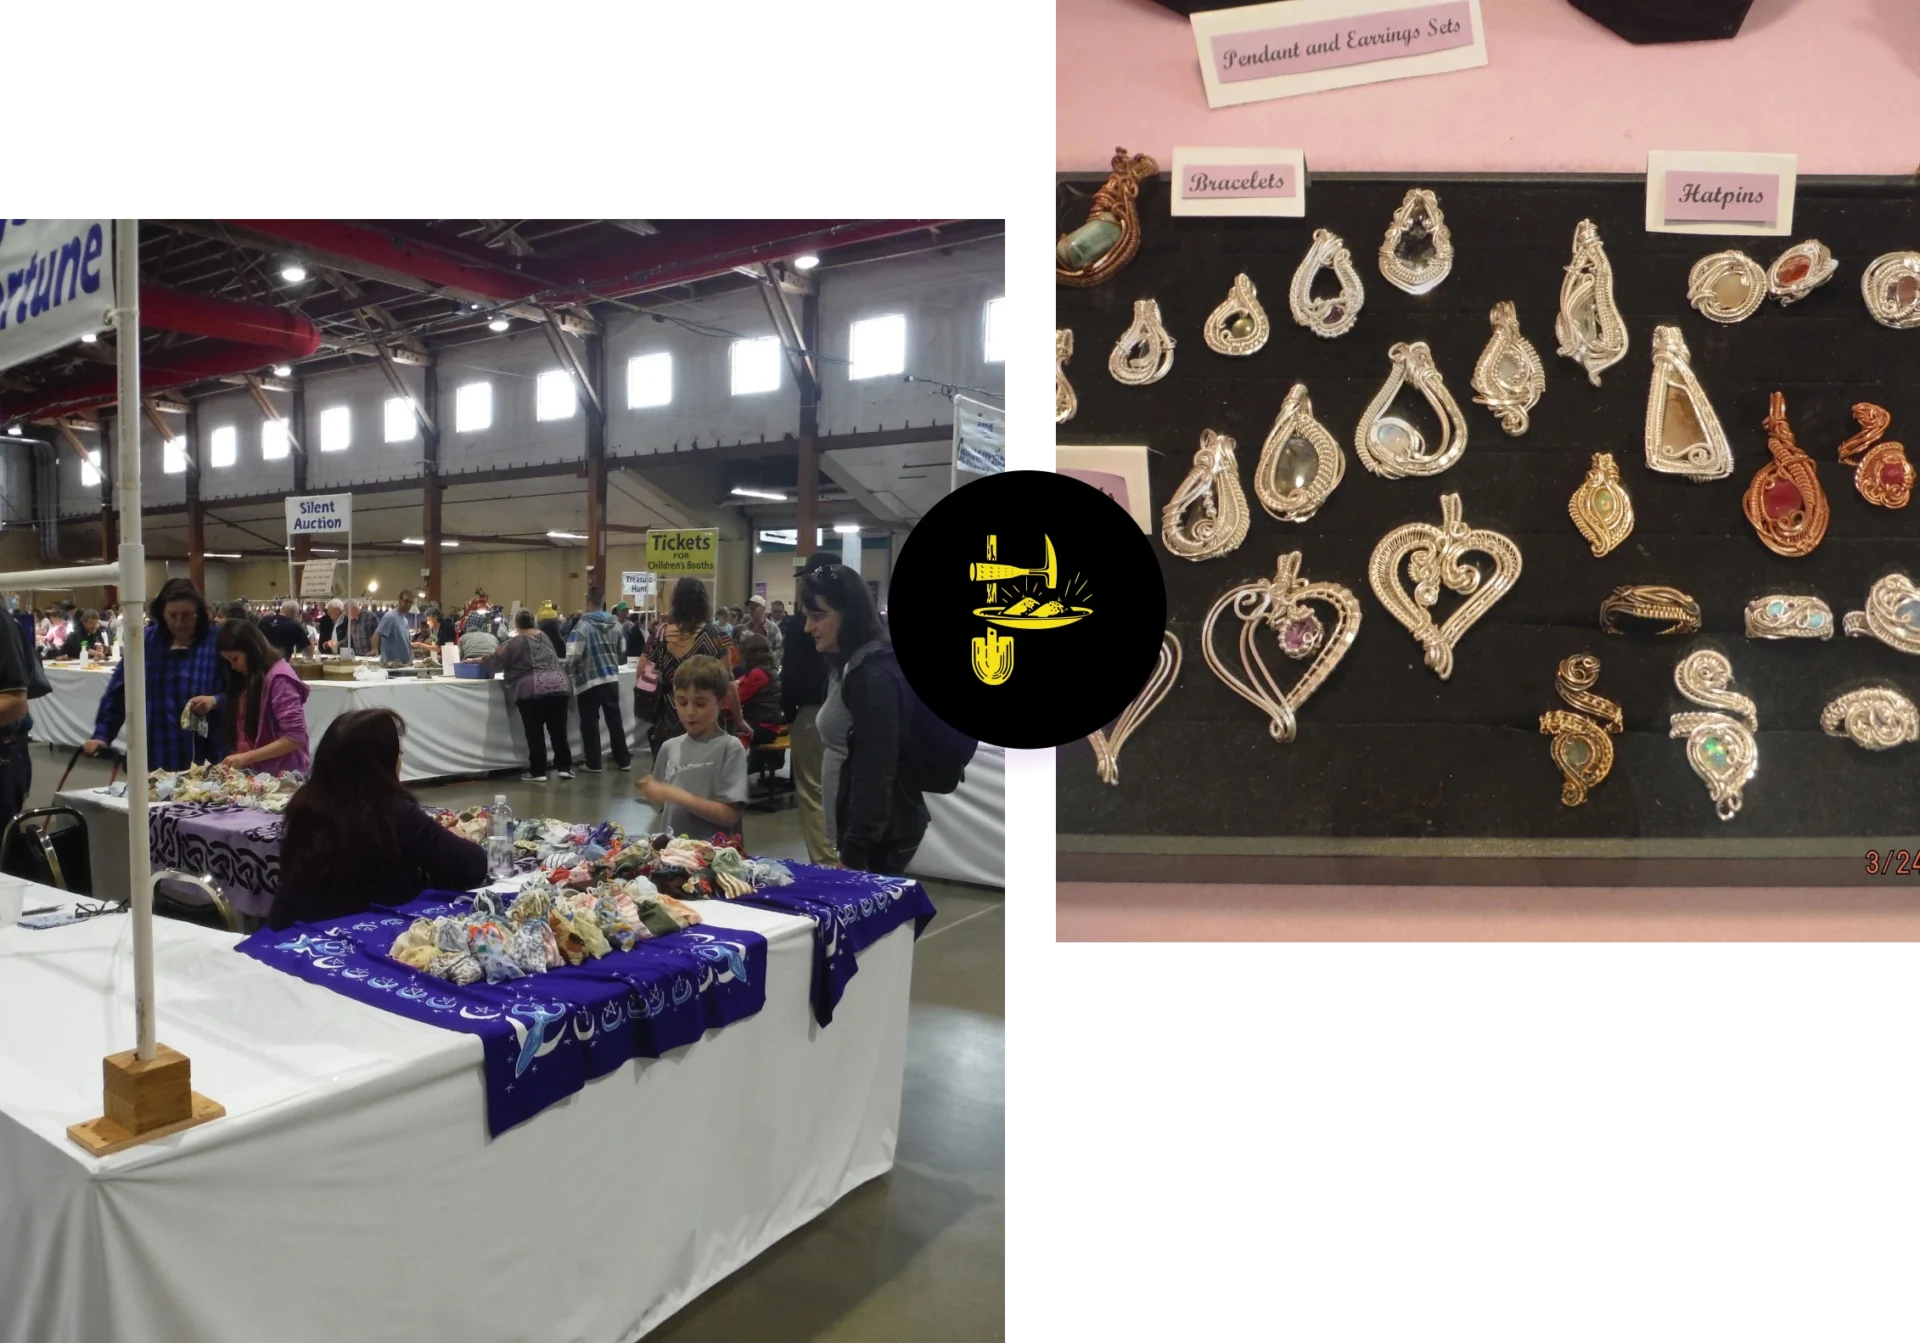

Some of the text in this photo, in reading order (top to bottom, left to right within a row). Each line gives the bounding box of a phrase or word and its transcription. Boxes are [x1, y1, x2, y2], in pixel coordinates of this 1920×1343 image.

[1223, 17, 1461, 70] Pendant and Earrings Sets
[1189, 170, 1284, 192] Bracelets
[1678, 183, 1764, 210] Hatpins
[0, 223, 102, 330] rtune
[300, 501, 335, 514] Silent
[294, 517, 342, 530] Auction
[652, 533, 710, 551] Tickets
[647, 561, 685, 570] Children's
[687, 561, 714, 570] Booths
[631, 585, 647, 593] Hunt
